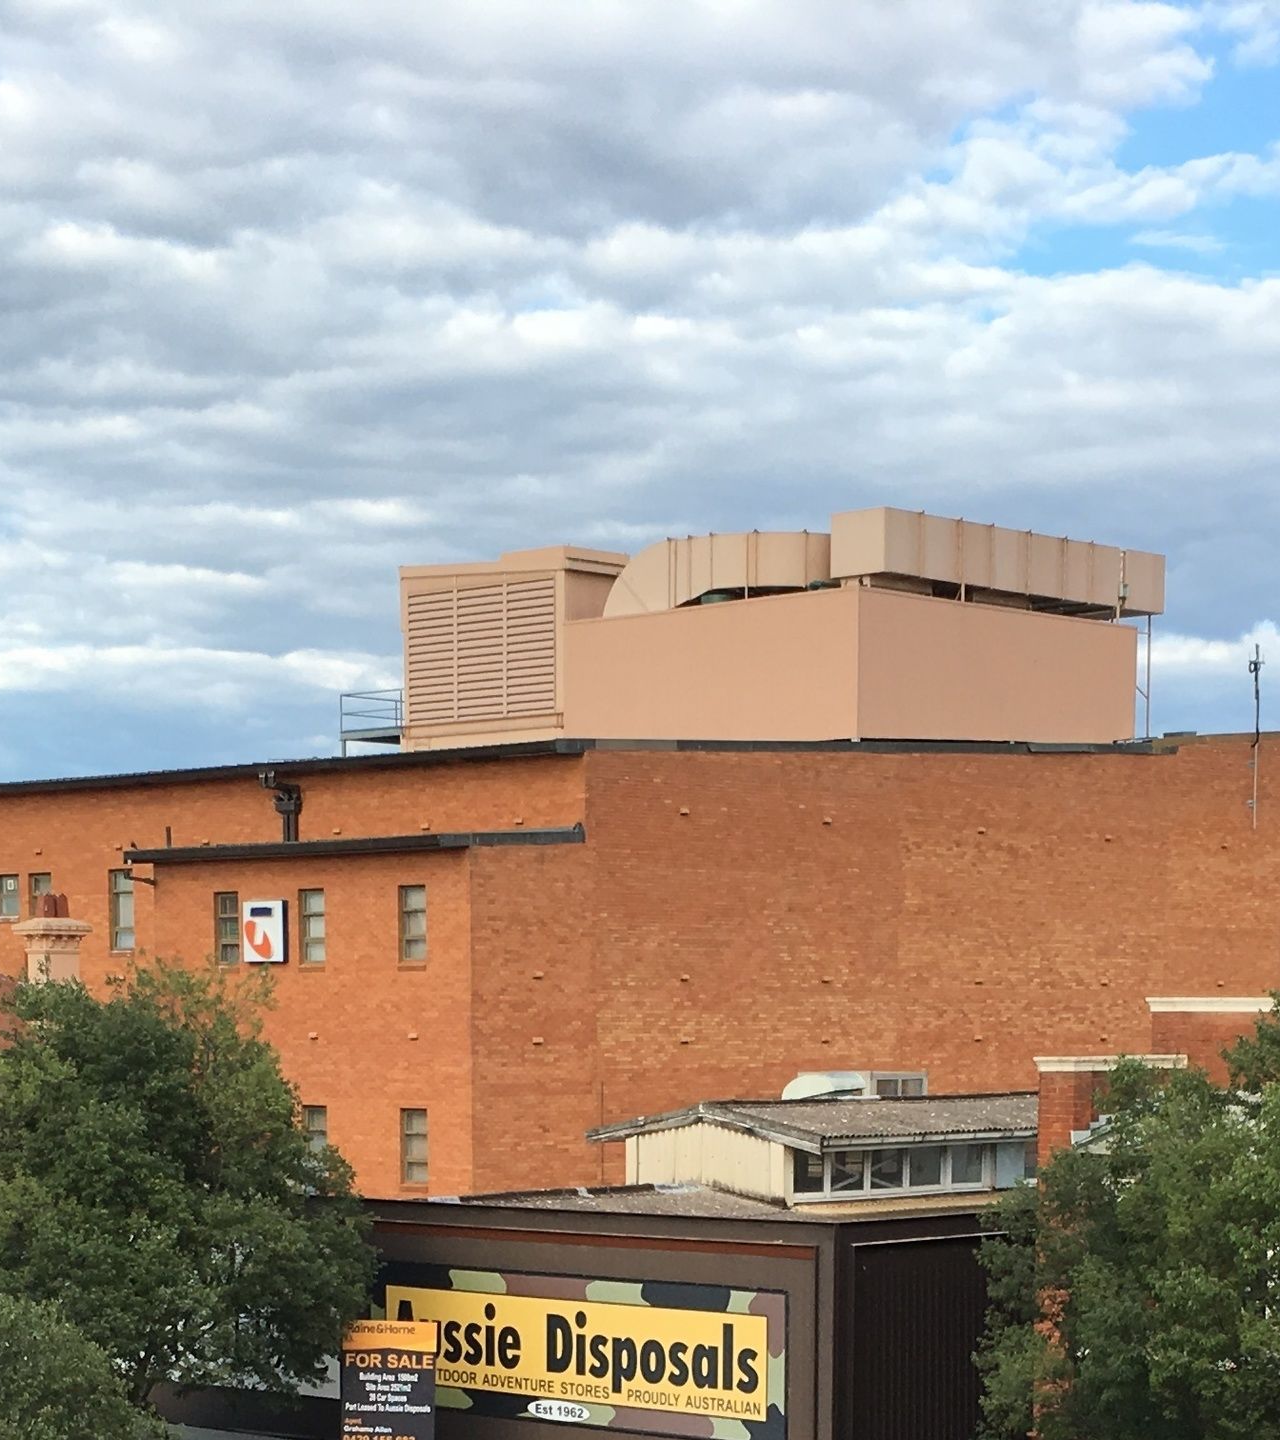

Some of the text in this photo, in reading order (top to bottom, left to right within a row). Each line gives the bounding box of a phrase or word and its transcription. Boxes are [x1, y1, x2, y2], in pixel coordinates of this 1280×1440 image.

[546, 1311, 759, 1394] Disposals
[345, 1353, 434, 1370] FOR SALE
[482, 1374, 555, 1393] ADVENTURE
[560, 1381, 610, 1400] STORES
[627, 1389, 680, 1407] PROUDLY
[685, 1395, 761, 1416] AUSTRALIAN
[385, 1404, 404, 1413] Aussie
[404, 1404, 431, 1414] Disposals
[535, 1403, 584, 1419] Est 1962
